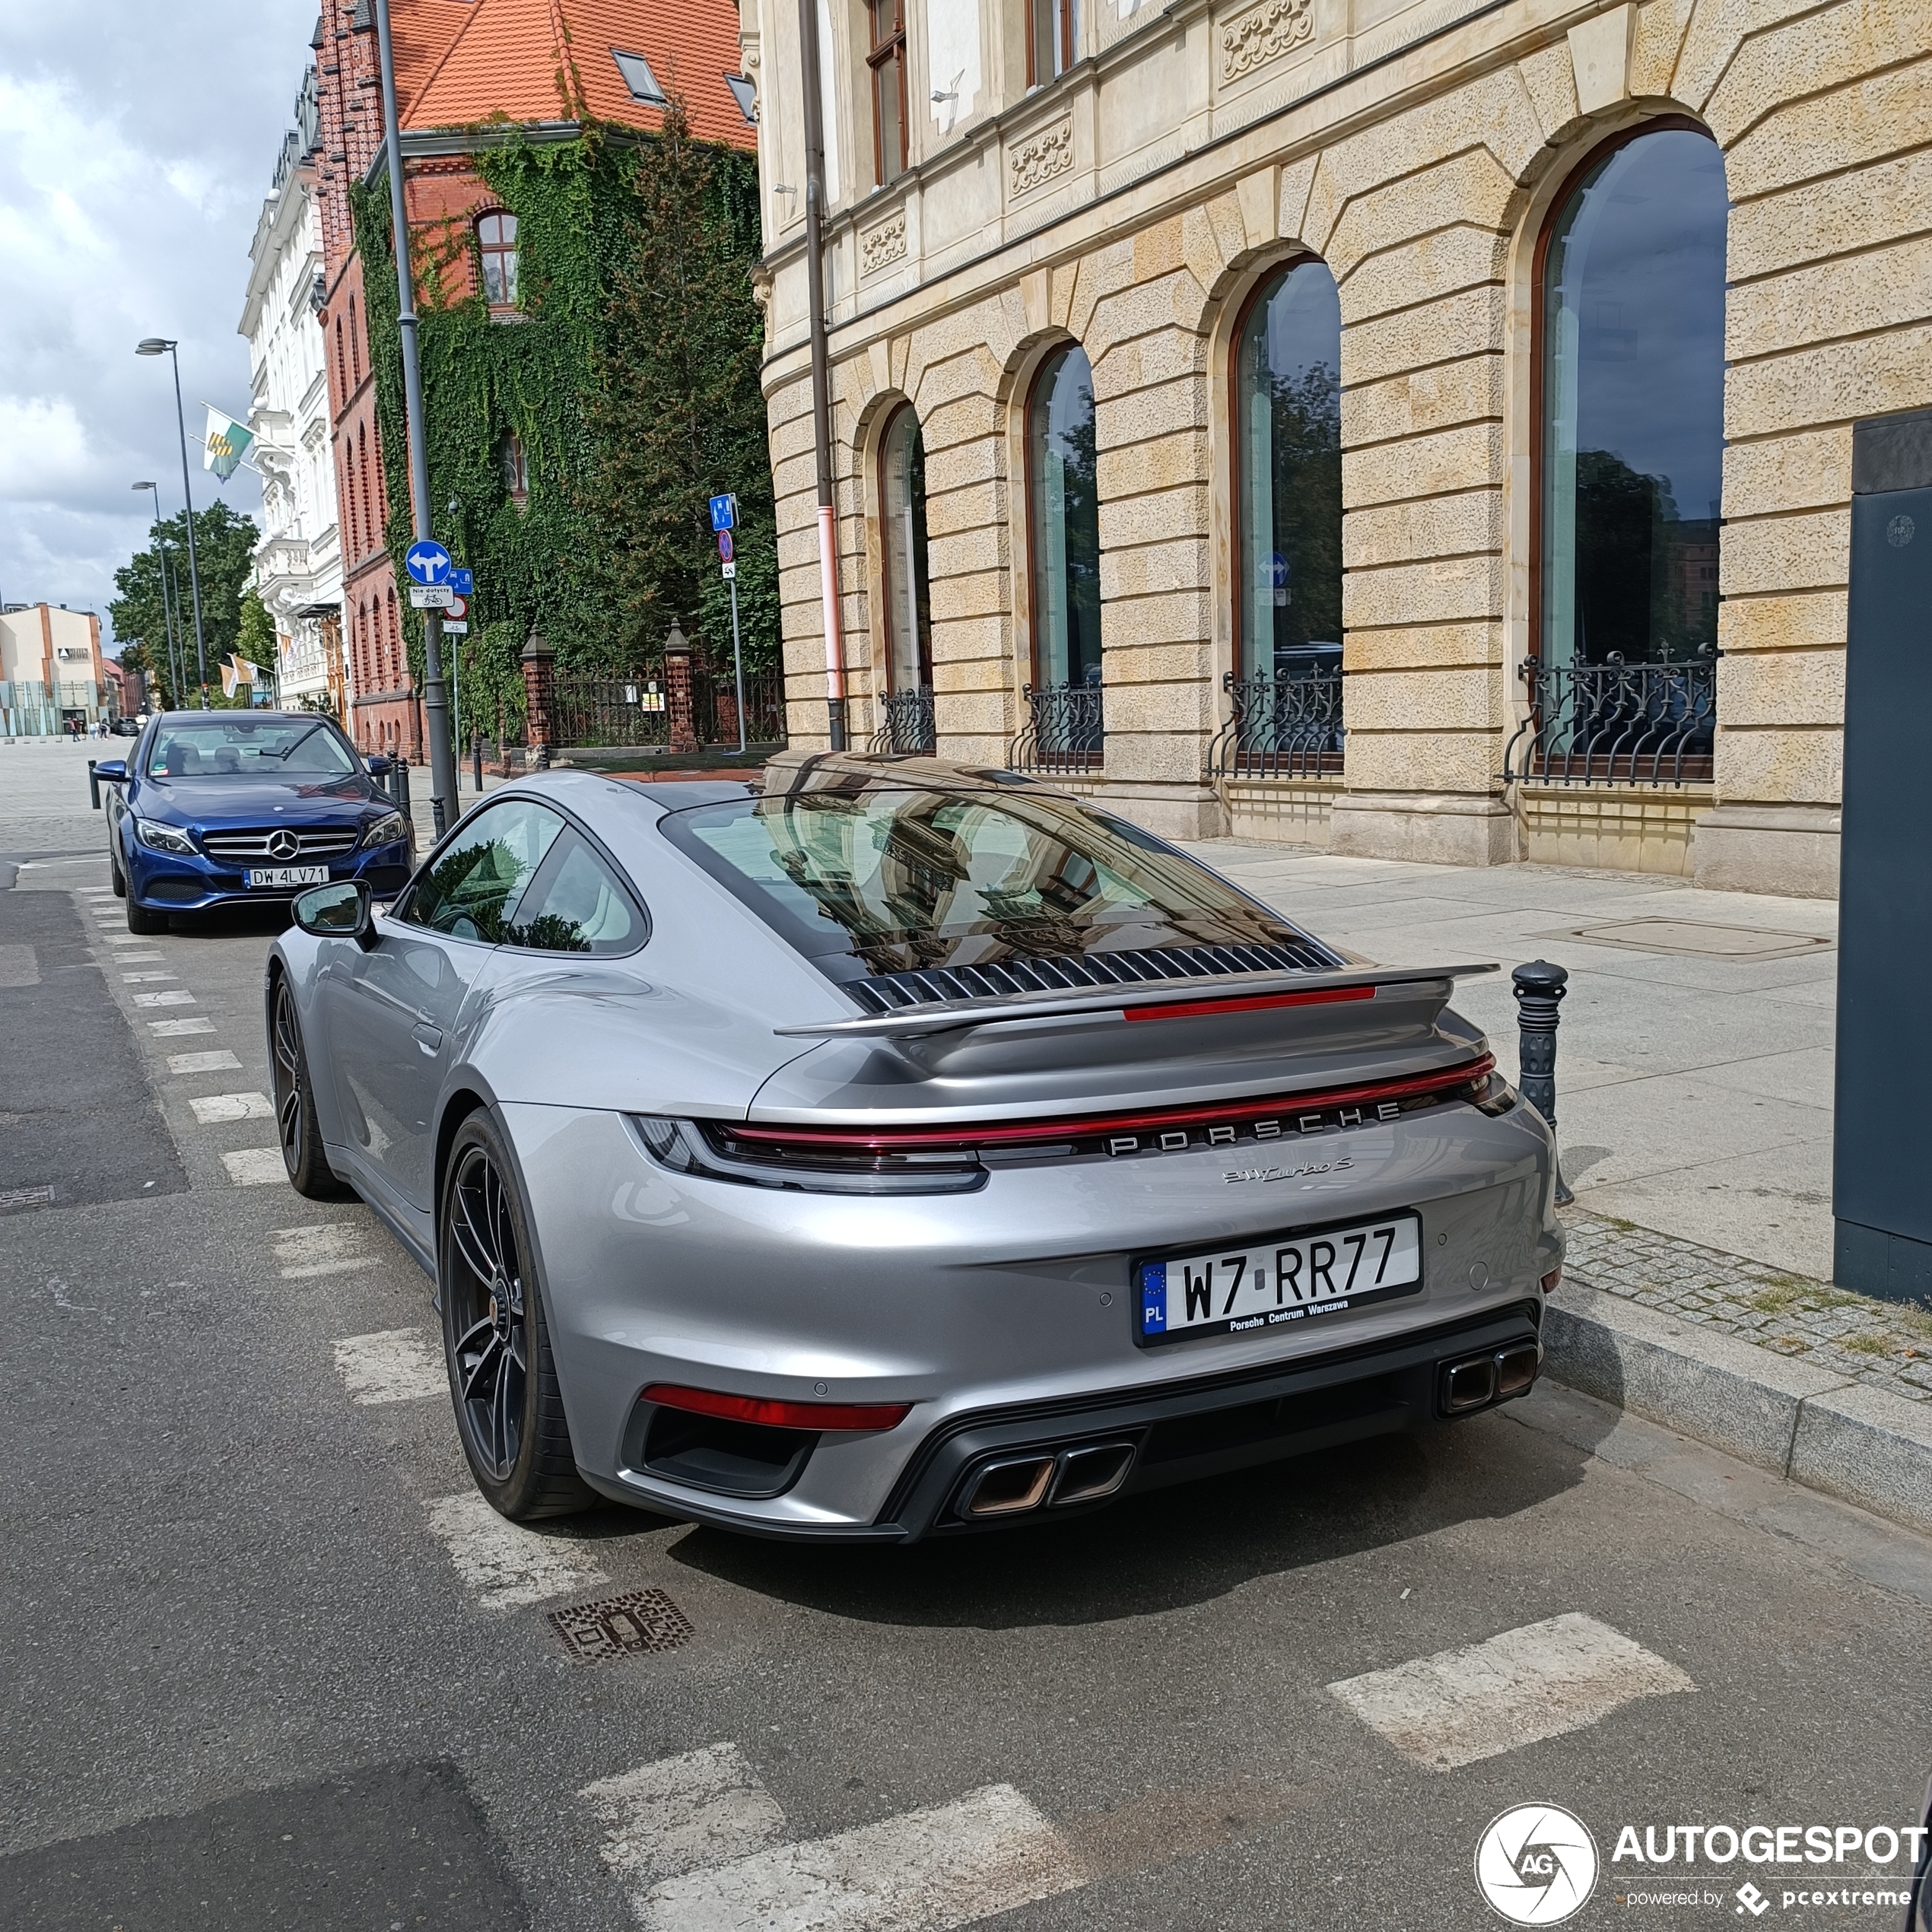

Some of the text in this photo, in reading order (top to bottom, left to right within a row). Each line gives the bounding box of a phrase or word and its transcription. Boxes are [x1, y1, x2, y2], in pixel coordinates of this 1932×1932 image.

[253, 867, 323, 885] DW 4LV71
[1110, 1101, 1401, 1155] PORSCHE
[1184, 1226, 1397, 1322] W7 RR77
[1145, 1306, 1164, 1323] PL
[1229, 1298, 1349, 1332] Porsche Centrum Warszawa
